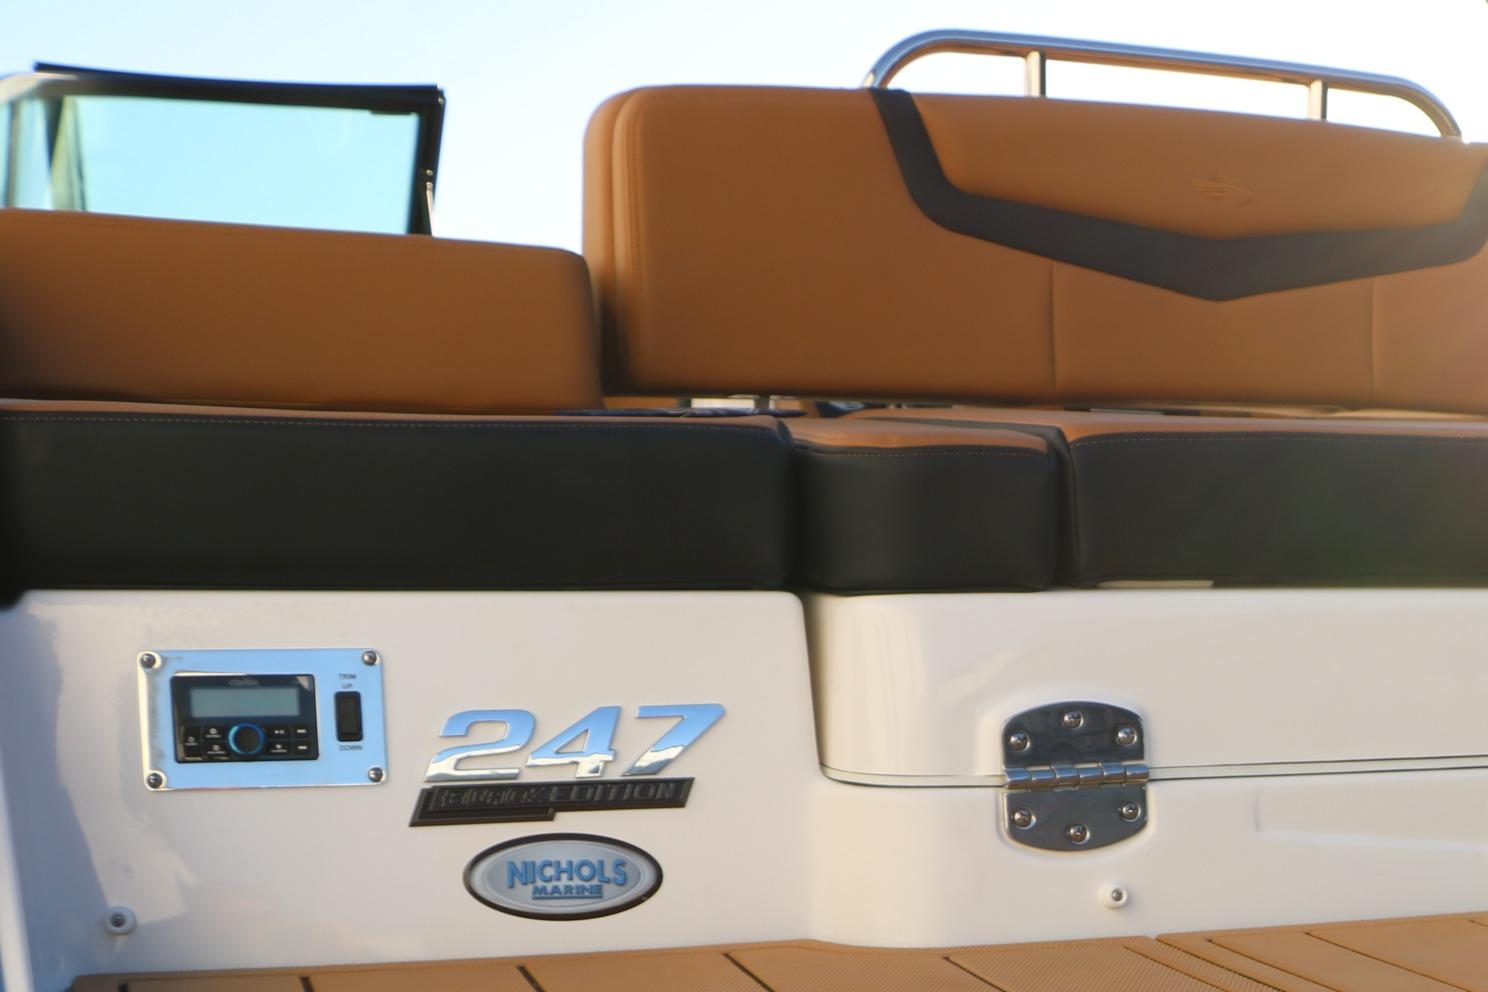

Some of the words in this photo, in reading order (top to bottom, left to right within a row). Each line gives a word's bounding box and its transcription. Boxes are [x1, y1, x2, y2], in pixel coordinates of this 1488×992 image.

[424, 703, 726, 782] 247
[550, 783, 677, 802] EDITION
[507, 859, 628, 888] NICHOLS
[532, 884, 603, 897] MARINE
